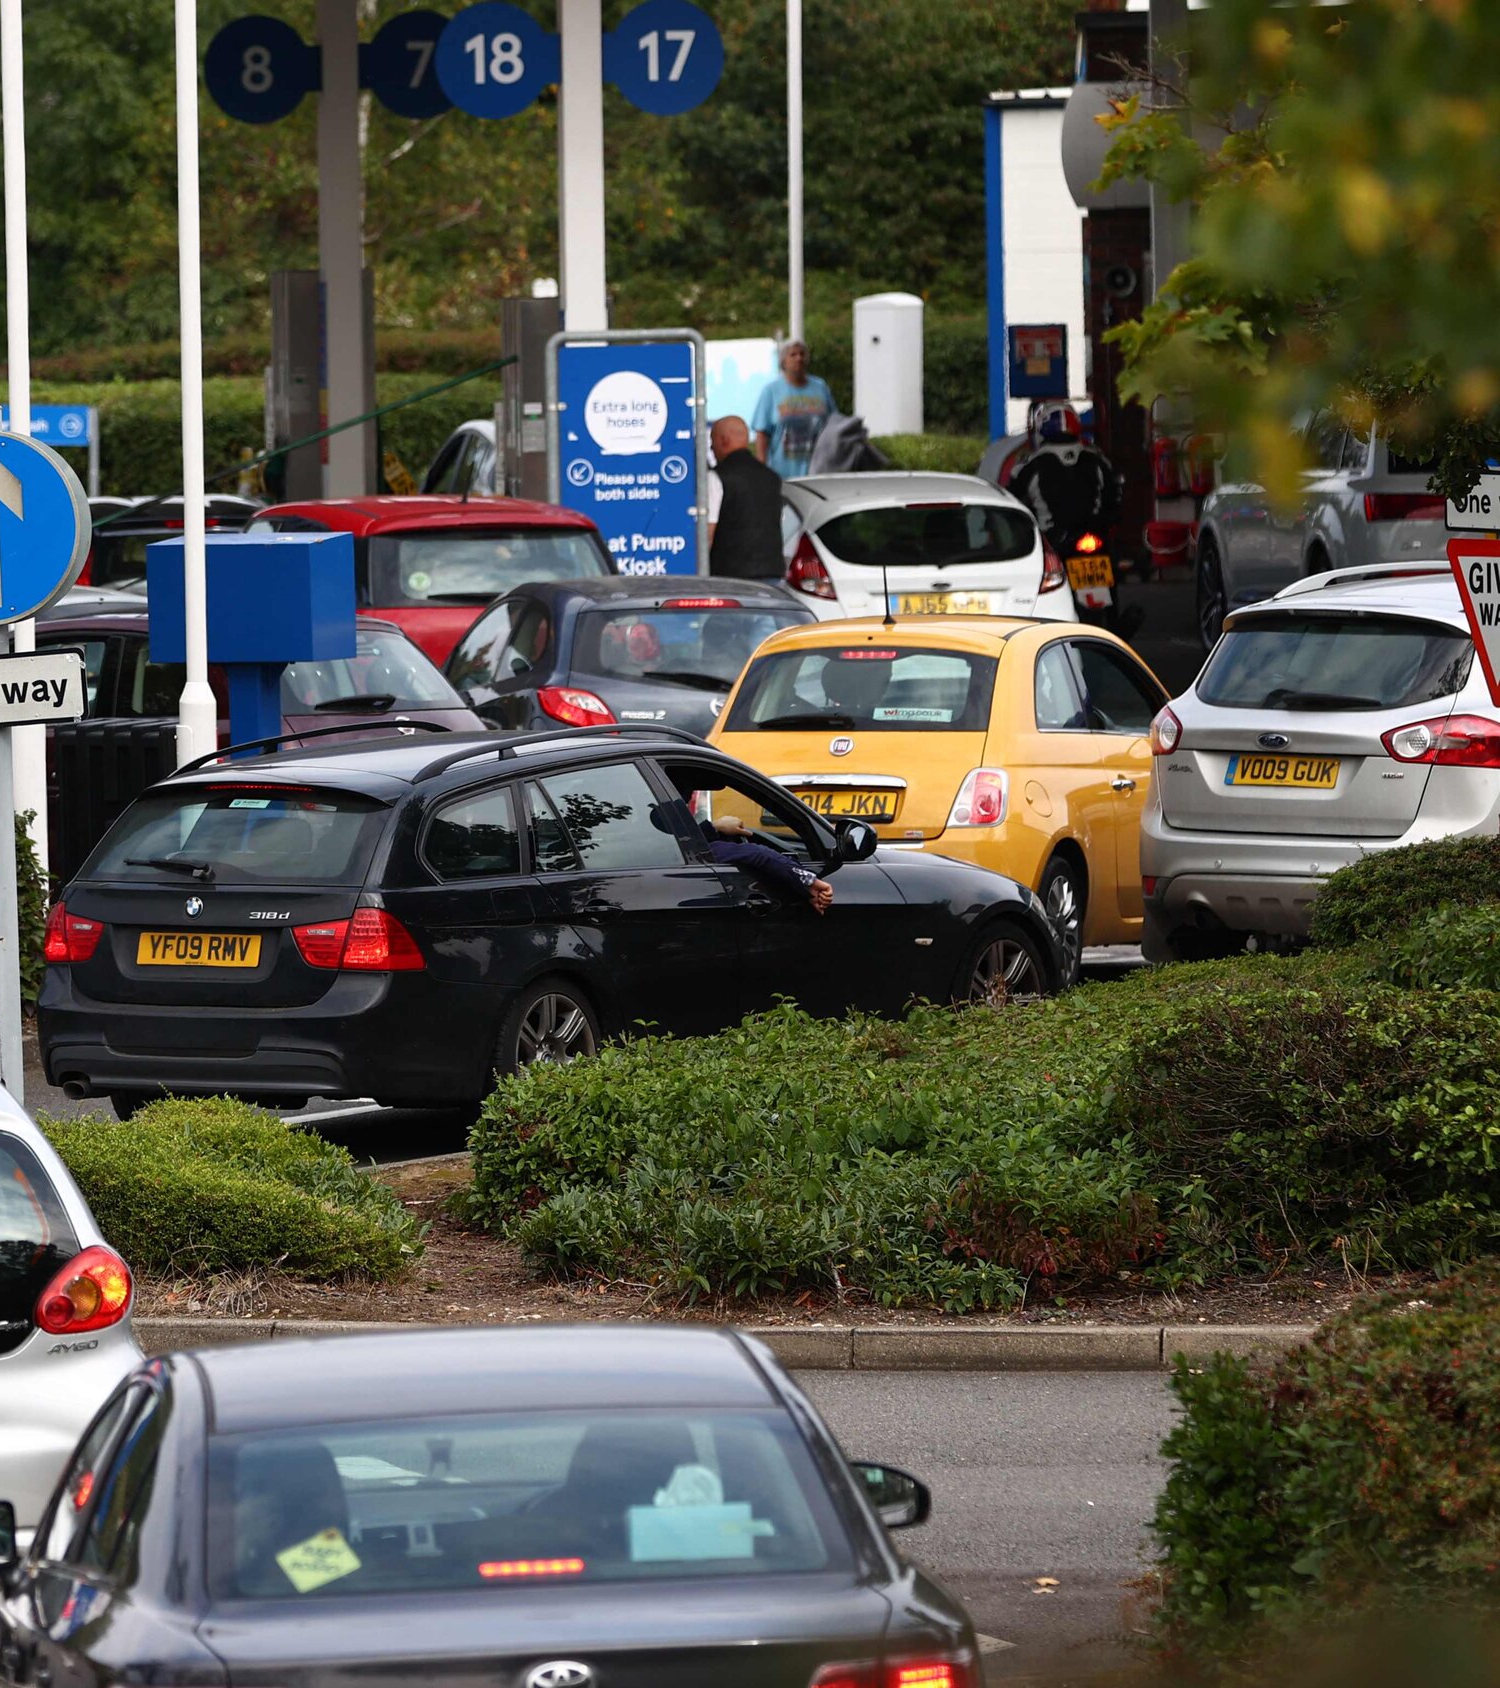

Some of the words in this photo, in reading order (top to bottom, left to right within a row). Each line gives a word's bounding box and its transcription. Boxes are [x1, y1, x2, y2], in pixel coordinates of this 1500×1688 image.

[406, 40, 436, 89] 7
[464, 33, 525, 86] 18
[638, 29, 696, 83] 17
[241, 45, 273, 94] 8
[592, 401, 627, 413] Extra
[631, 399, 660, 415] long
[607, 416, 646, 428] hoses
[595, 473, 636, 486] Please
[639, 474, 660, 485] use
[595, 488, 625, 501] both
[627, 487, 660, 501] sides
[608, 535, 627, 552] at
[632, 534, 686, 555] Pump
[617, 556, 666, 576] Kiosk
[1, 677, 69, 709] way
[1293, 760, 1337, 783] GUK
[841, 794, 888, 815] JKN
[248, 910, 291, 921] 318d
[150, 934, 203, 960] YF09
[207, 936, 252, 962] RMV
[46, 1340, 100, 1356] AYGO
